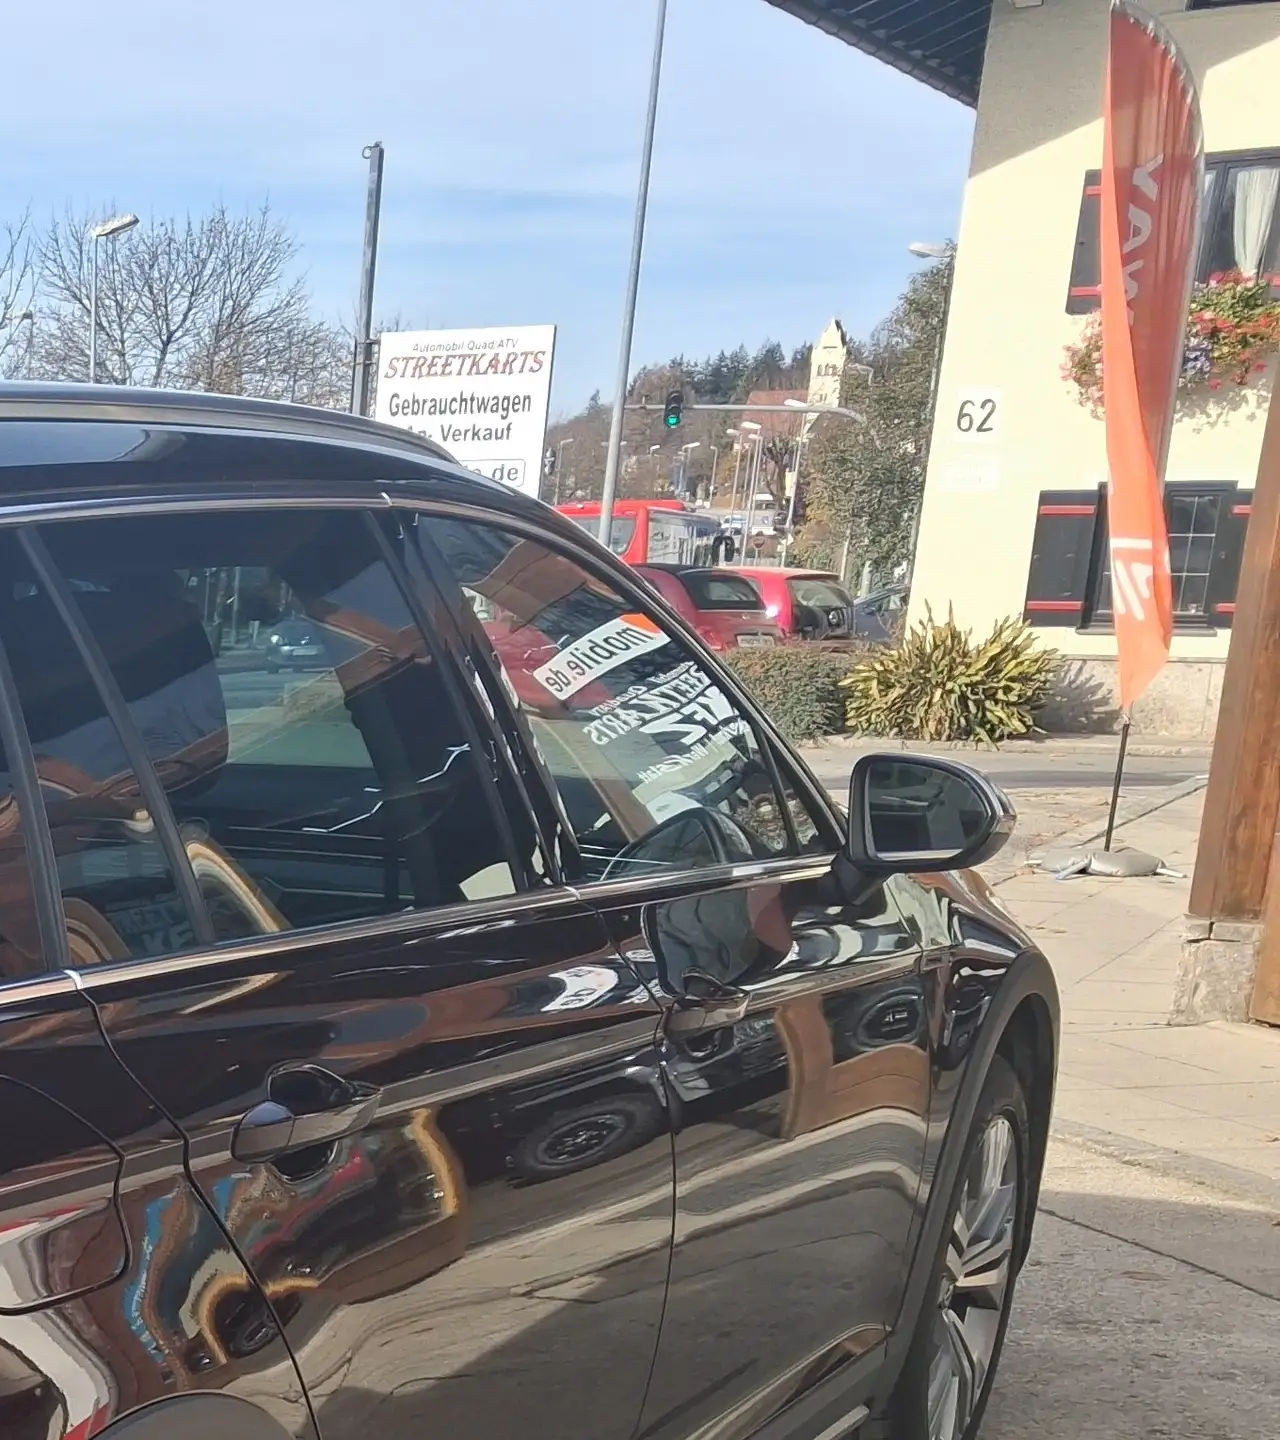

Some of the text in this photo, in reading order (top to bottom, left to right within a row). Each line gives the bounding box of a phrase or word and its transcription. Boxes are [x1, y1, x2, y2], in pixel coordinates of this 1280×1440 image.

[412, 341, 465, 353] Automobil
[384, 350, 546, 379] STREETKARTS
[389, 390, 532, 419] Gebrauchtwagen
[956, 398, 997, 432] 62
[440, 422, 513, 442] Verkauf
